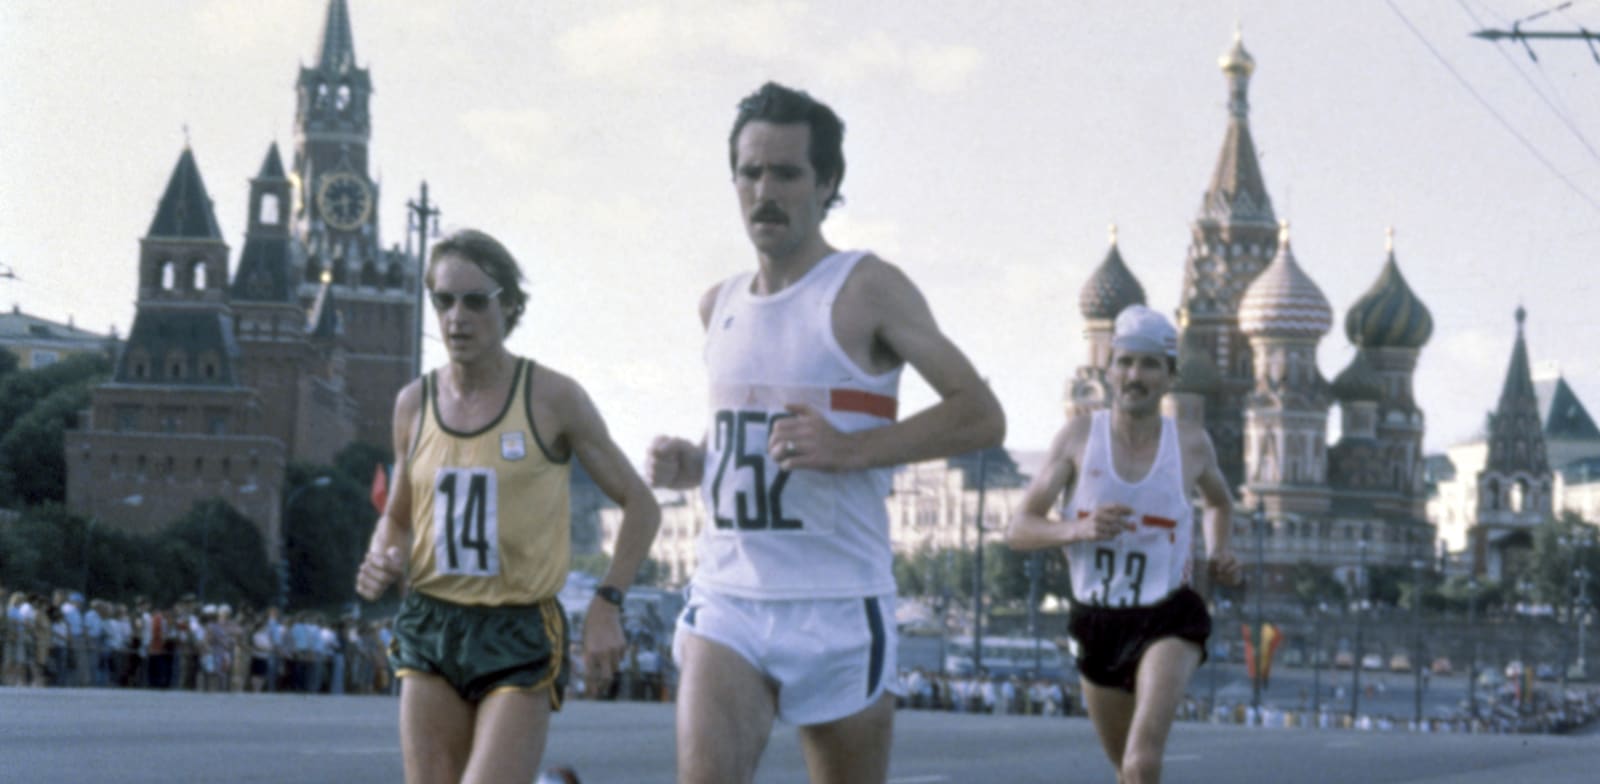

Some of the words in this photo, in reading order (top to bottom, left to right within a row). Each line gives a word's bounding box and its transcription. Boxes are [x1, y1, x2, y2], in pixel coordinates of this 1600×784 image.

[712, 410, 803, 529] 252
[438, 472, 489, 570] 14
[1092, 548, 1146, 607] 33
